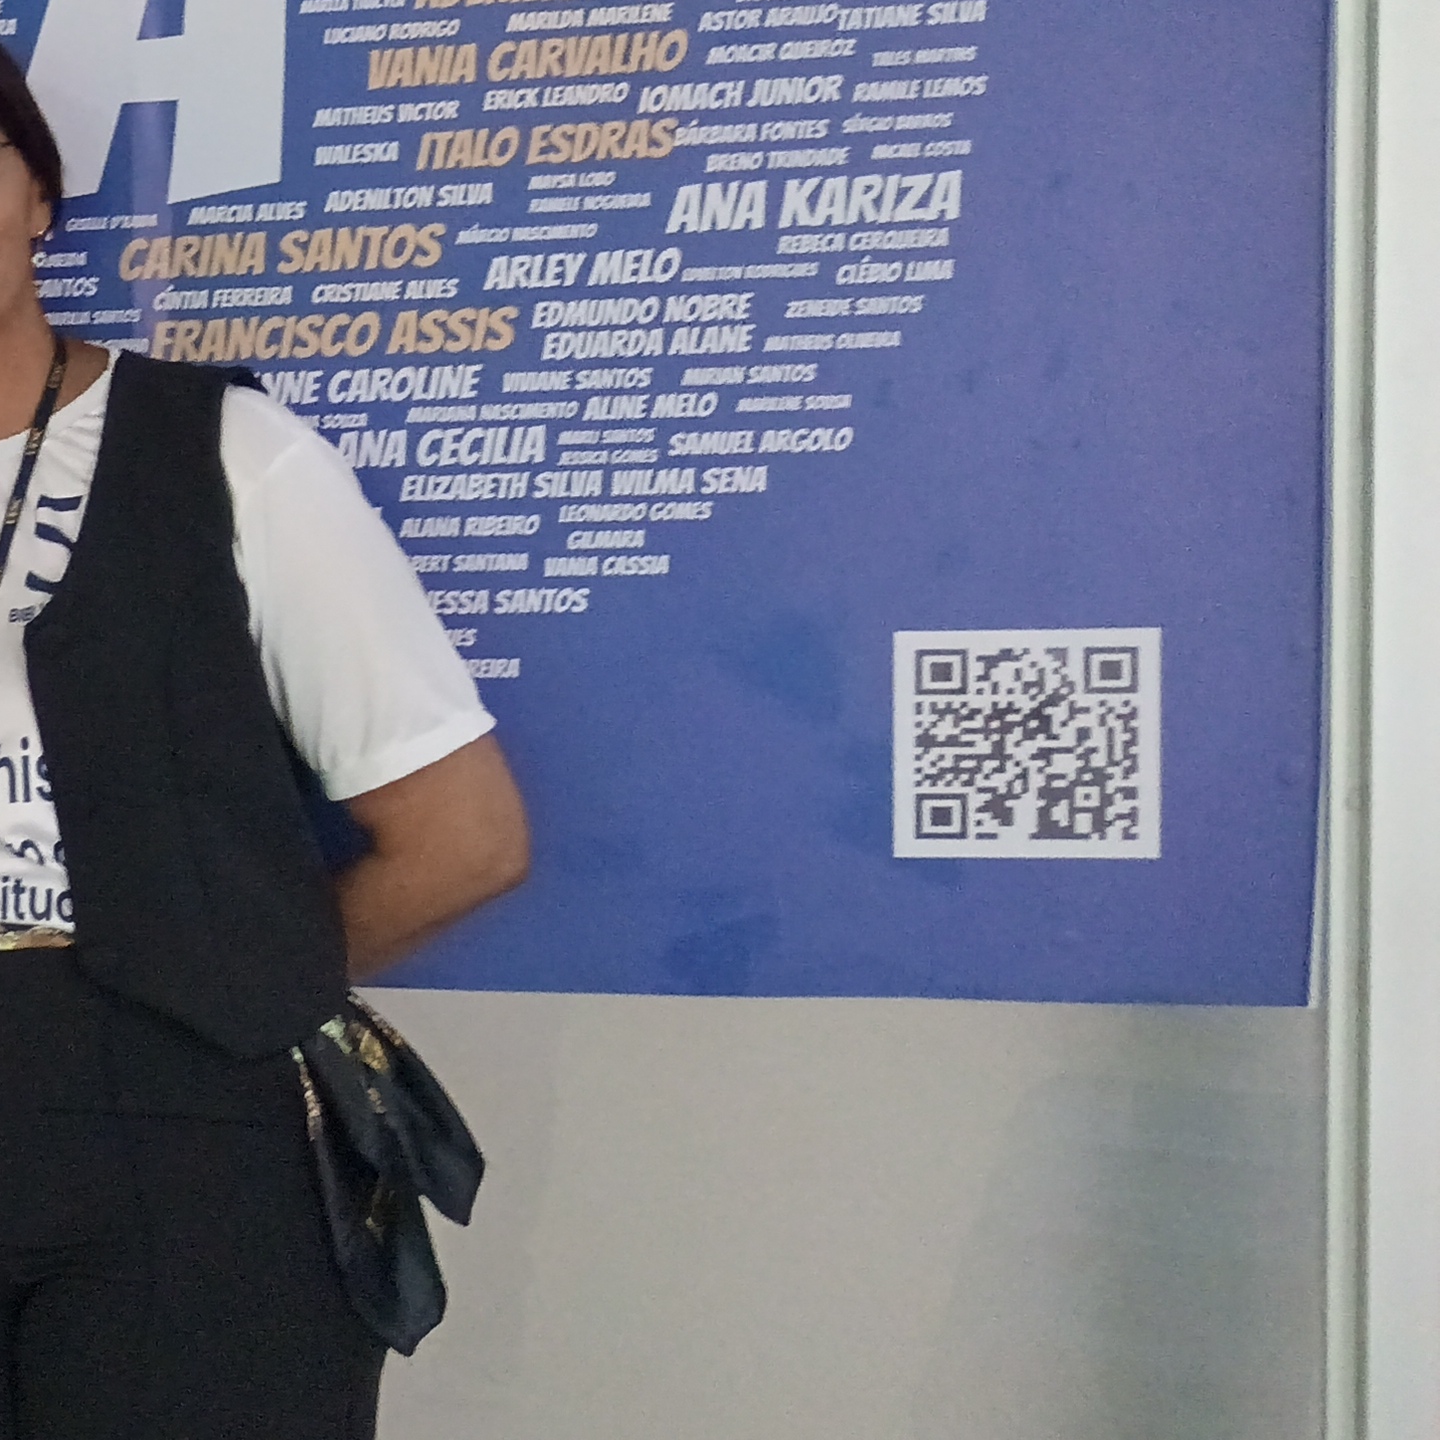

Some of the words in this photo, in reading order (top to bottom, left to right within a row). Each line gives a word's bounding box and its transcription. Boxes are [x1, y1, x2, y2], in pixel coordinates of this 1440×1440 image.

[368, 43, 477, 90] VANIA
[488, 29, 688, 81] CARVALHO
[416, 126, 519, 170] ITALO
[526, 118, 679, 164] ESDRAS
[666, 180, 767, 233] ANA
[778, 170, 962, 228] KARIZA
[120, 231, 266, 281] CARINA
[277, 223, 446, 273] SANTOS
[483, 253, 587, 290] ARLEY
[587, 247, 681, 286] MELO
[150, 311, 381, 362] FRANCISCO
[386, 306, 518, 354] ASSIS
